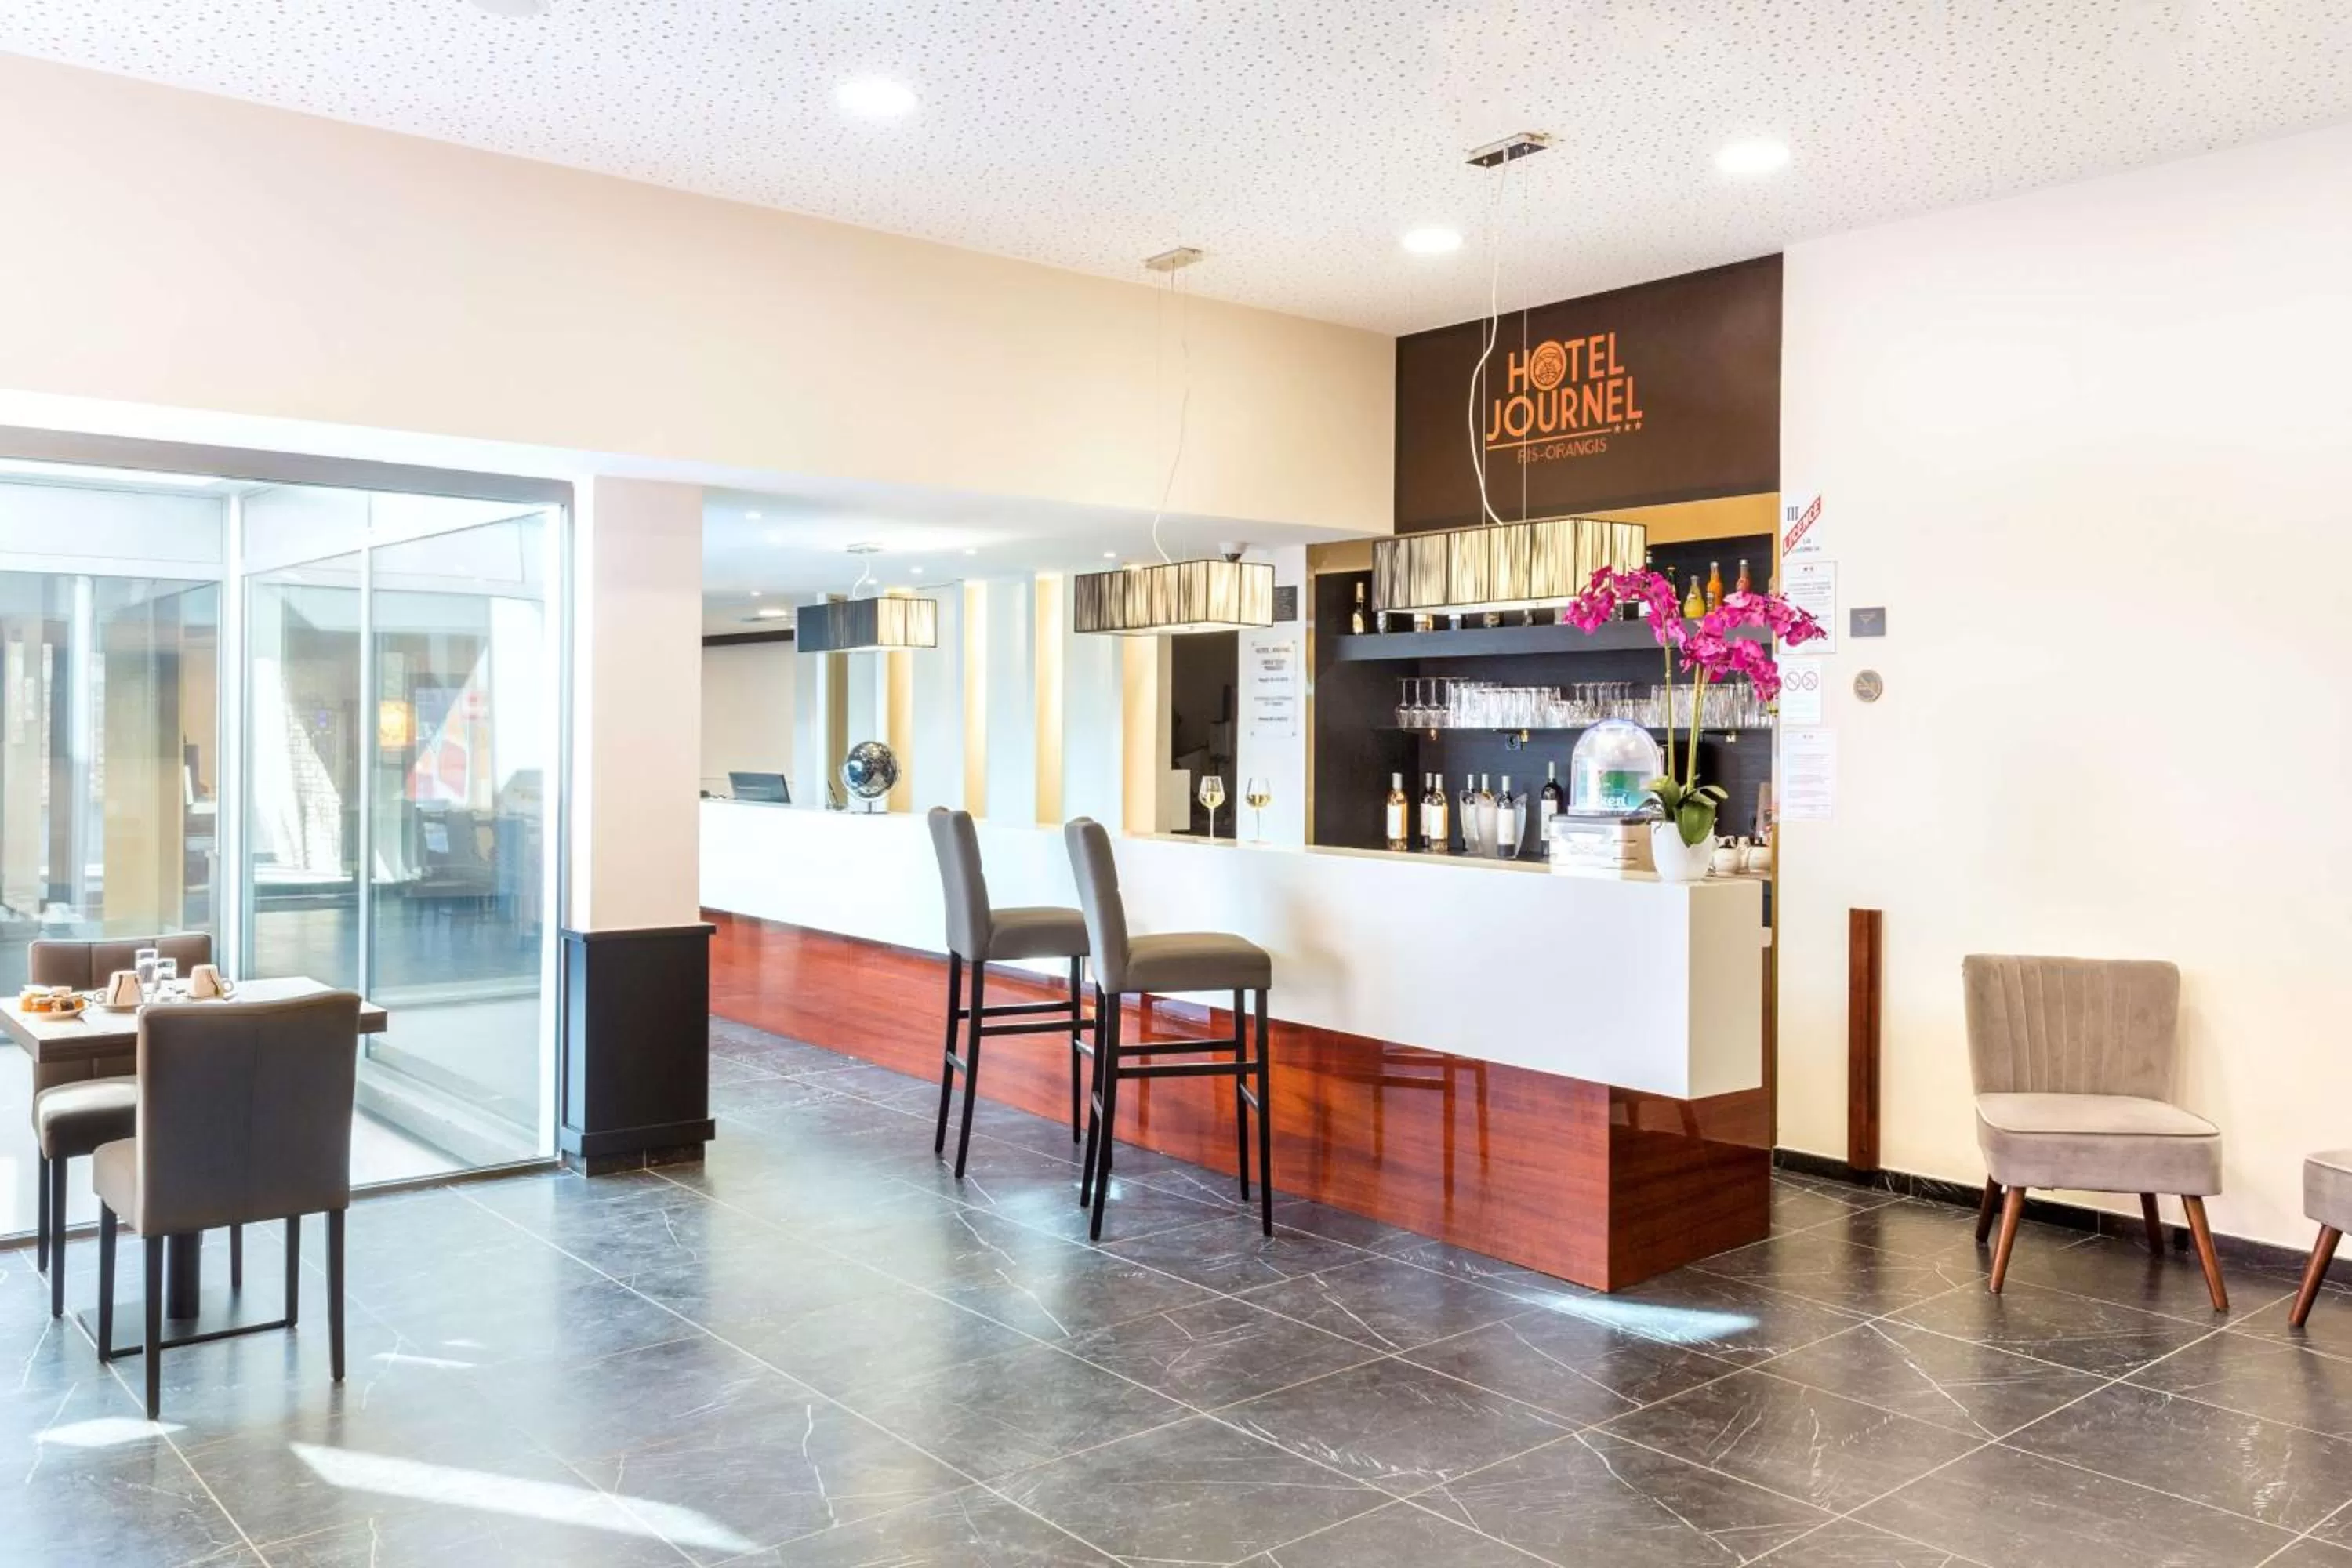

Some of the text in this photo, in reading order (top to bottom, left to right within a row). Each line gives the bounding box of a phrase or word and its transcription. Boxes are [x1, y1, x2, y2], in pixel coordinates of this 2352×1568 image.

[1508, 332, 1625, 393] HOTEL
[1486, 376, 1644, 442] JOURNEL
[1517, 437, 1608, 465] RIS-ORANGIS
